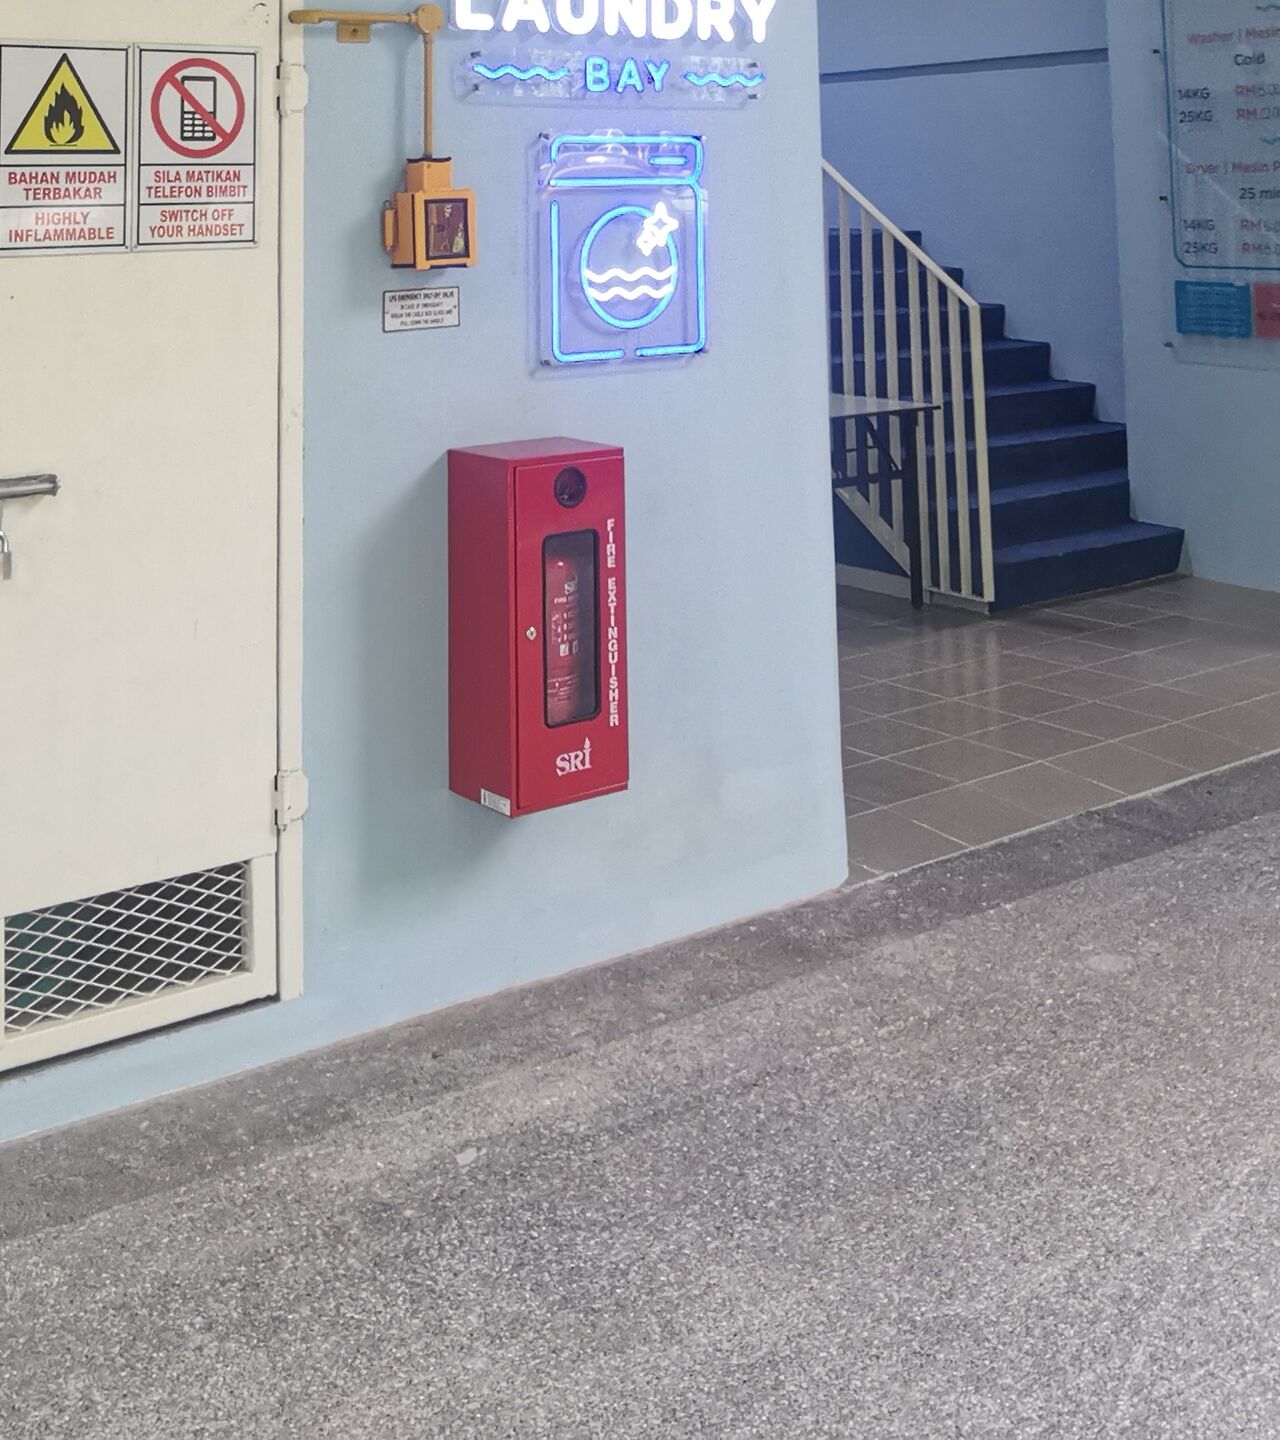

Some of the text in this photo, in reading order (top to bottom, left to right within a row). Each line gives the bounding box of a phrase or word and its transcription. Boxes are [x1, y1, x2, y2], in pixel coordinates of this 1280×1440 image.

[1234, 52, 1266, 67] Cold
[584, 55, 671, 94] BAY
[1179, 110, 1213, 123] 25KG
[7, 170, 118, 185] BAHAN MUDAH
[153, 170, 241, 184] SILA MATIKAN
[23, 187, 103, 201] TERBAKAR
[145, 184, 249, 199] TELEFON BIMBIT
[1239, 187, 1256, 200] 25
[34, 210, 91, 226] HIGHLY
[159, 208, 235, 223] SWITCH OFF
[8, 227, 115, 243] INFLAMMABLE
[149, 223, 246, 239] YOUR HANDSET
[1183, 241, 1218, 255] 25KG
[607, 518, 619, 727] FIRE EXTINGUISHER
